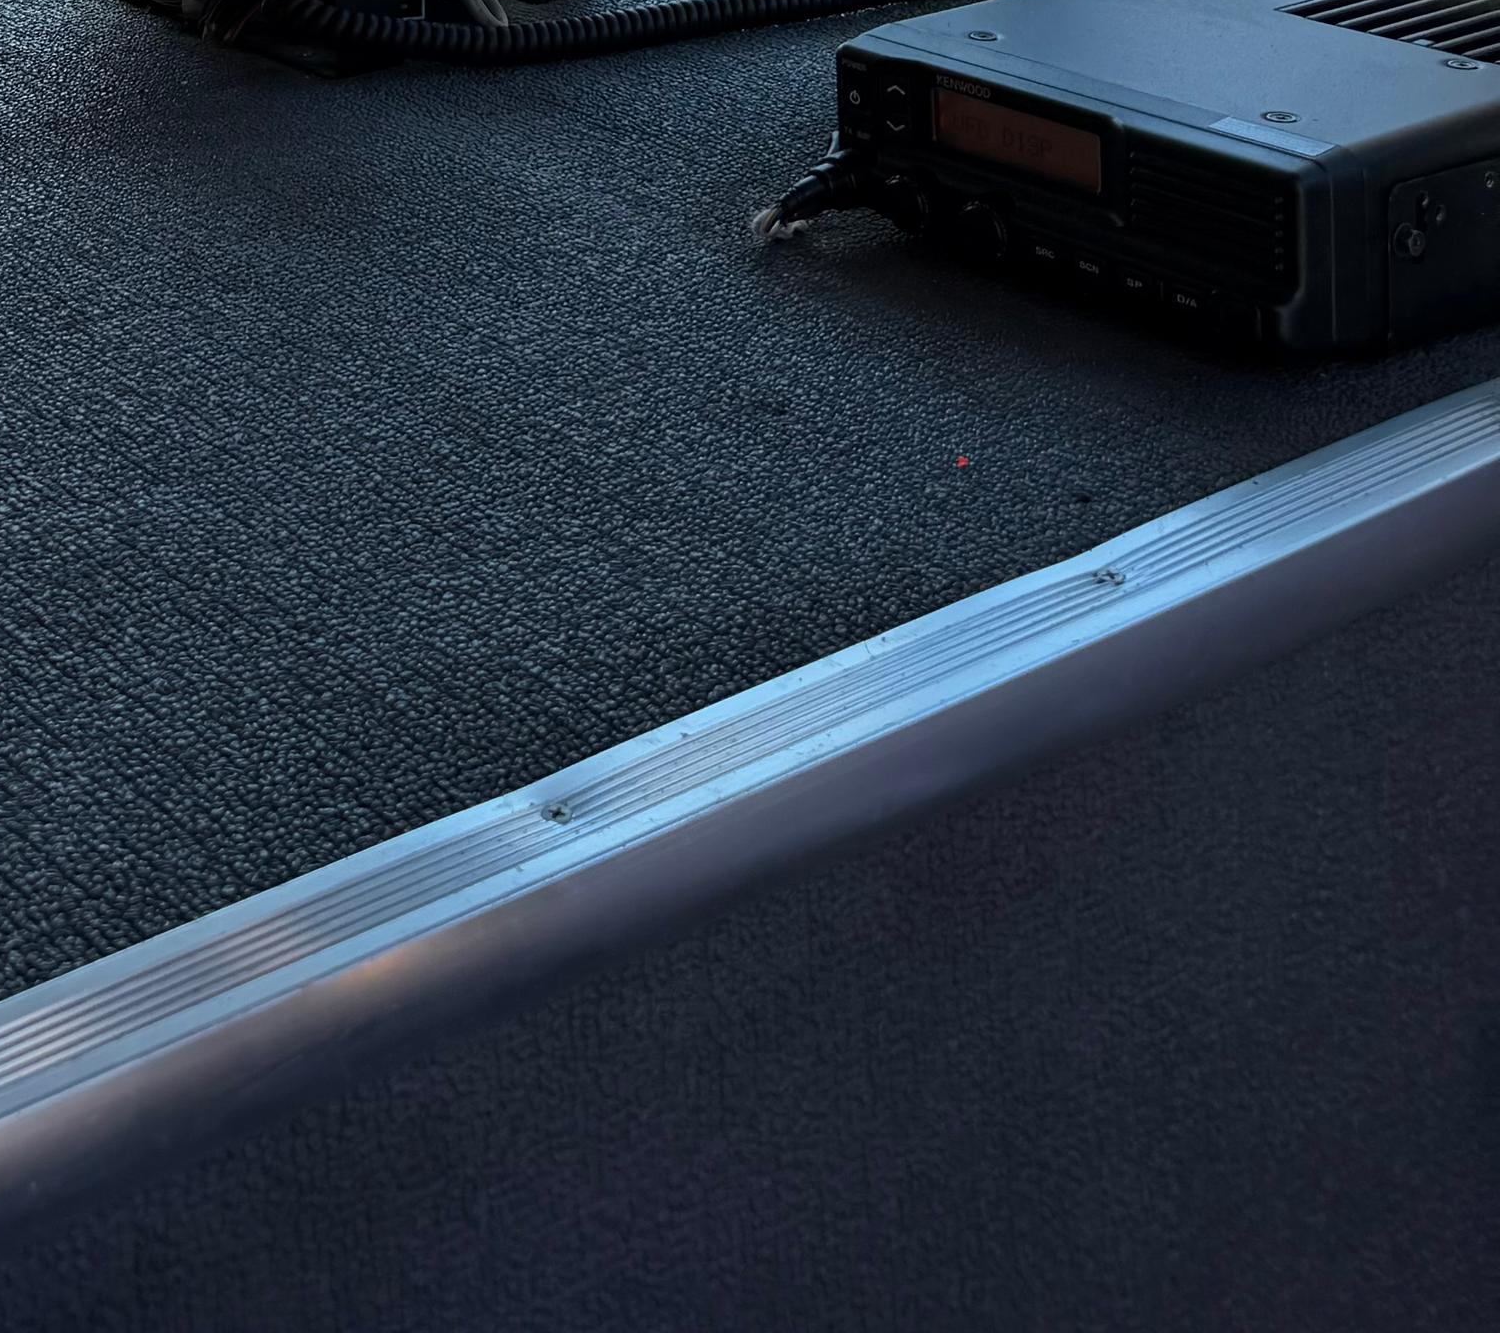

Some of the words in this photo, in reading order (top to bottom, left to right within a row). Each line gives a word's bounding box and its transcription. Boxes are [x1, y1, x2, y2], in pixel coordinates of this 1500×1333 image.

[936, 74, 992, 99] KENWOOD
[1078, 261, 1099, 274] SCN
[1176, 294, 1197, 308] D/A
